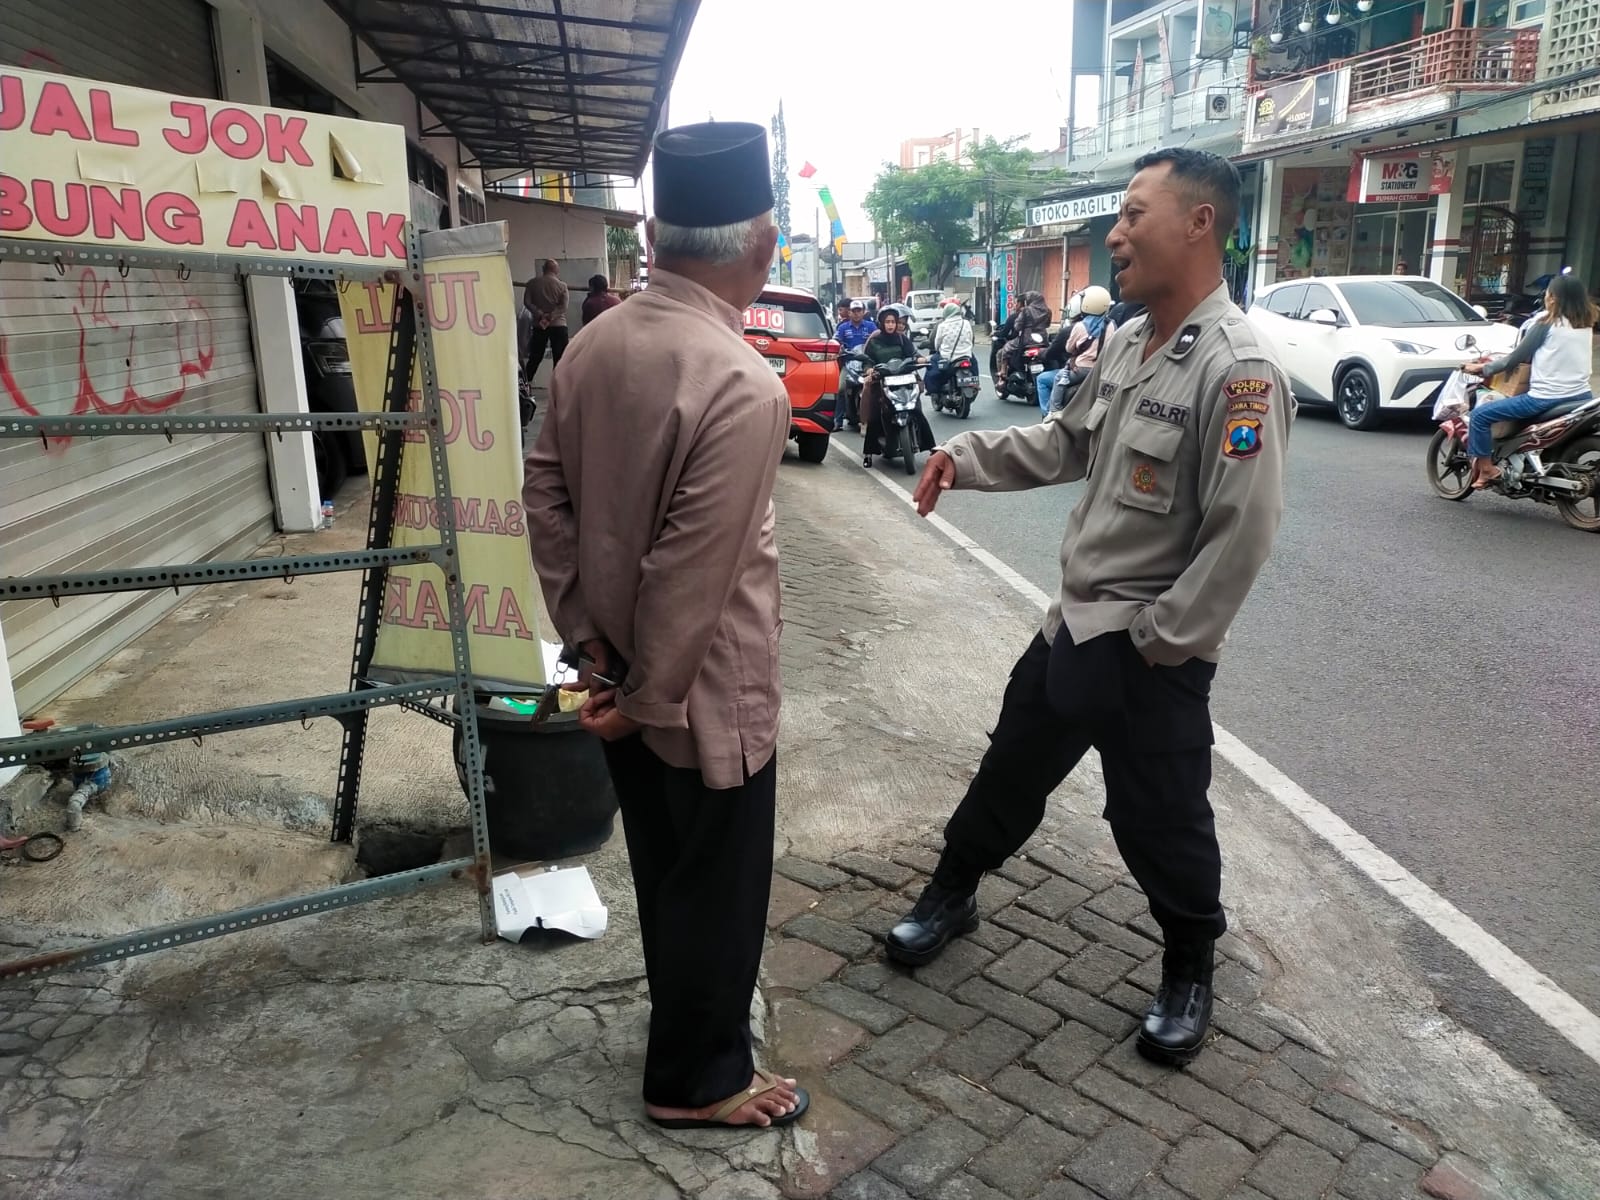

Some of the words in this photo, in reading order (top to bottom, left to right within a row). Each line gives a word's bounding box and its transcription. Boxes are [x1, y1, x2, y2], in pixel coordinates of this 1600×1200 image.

[163, 101, 313, 167] JOK
[1381, 162, 1418, 180] M&G
[1380, 180, 1417, 190] STATIONERY
[0, 174, 203, 245] BUNG
[227, 199, 406, 259] ANAK
[1042, 204, 1069, 222] TOKO
[1073, 197, 1106, 217] RAGIL
[743, 309, 783, 329] 110
[1230, 380, 1267, 391] POLRES
[1139, 399, 1186, 422] POLRI
[1231, 402, 1248, 411] JAWA
